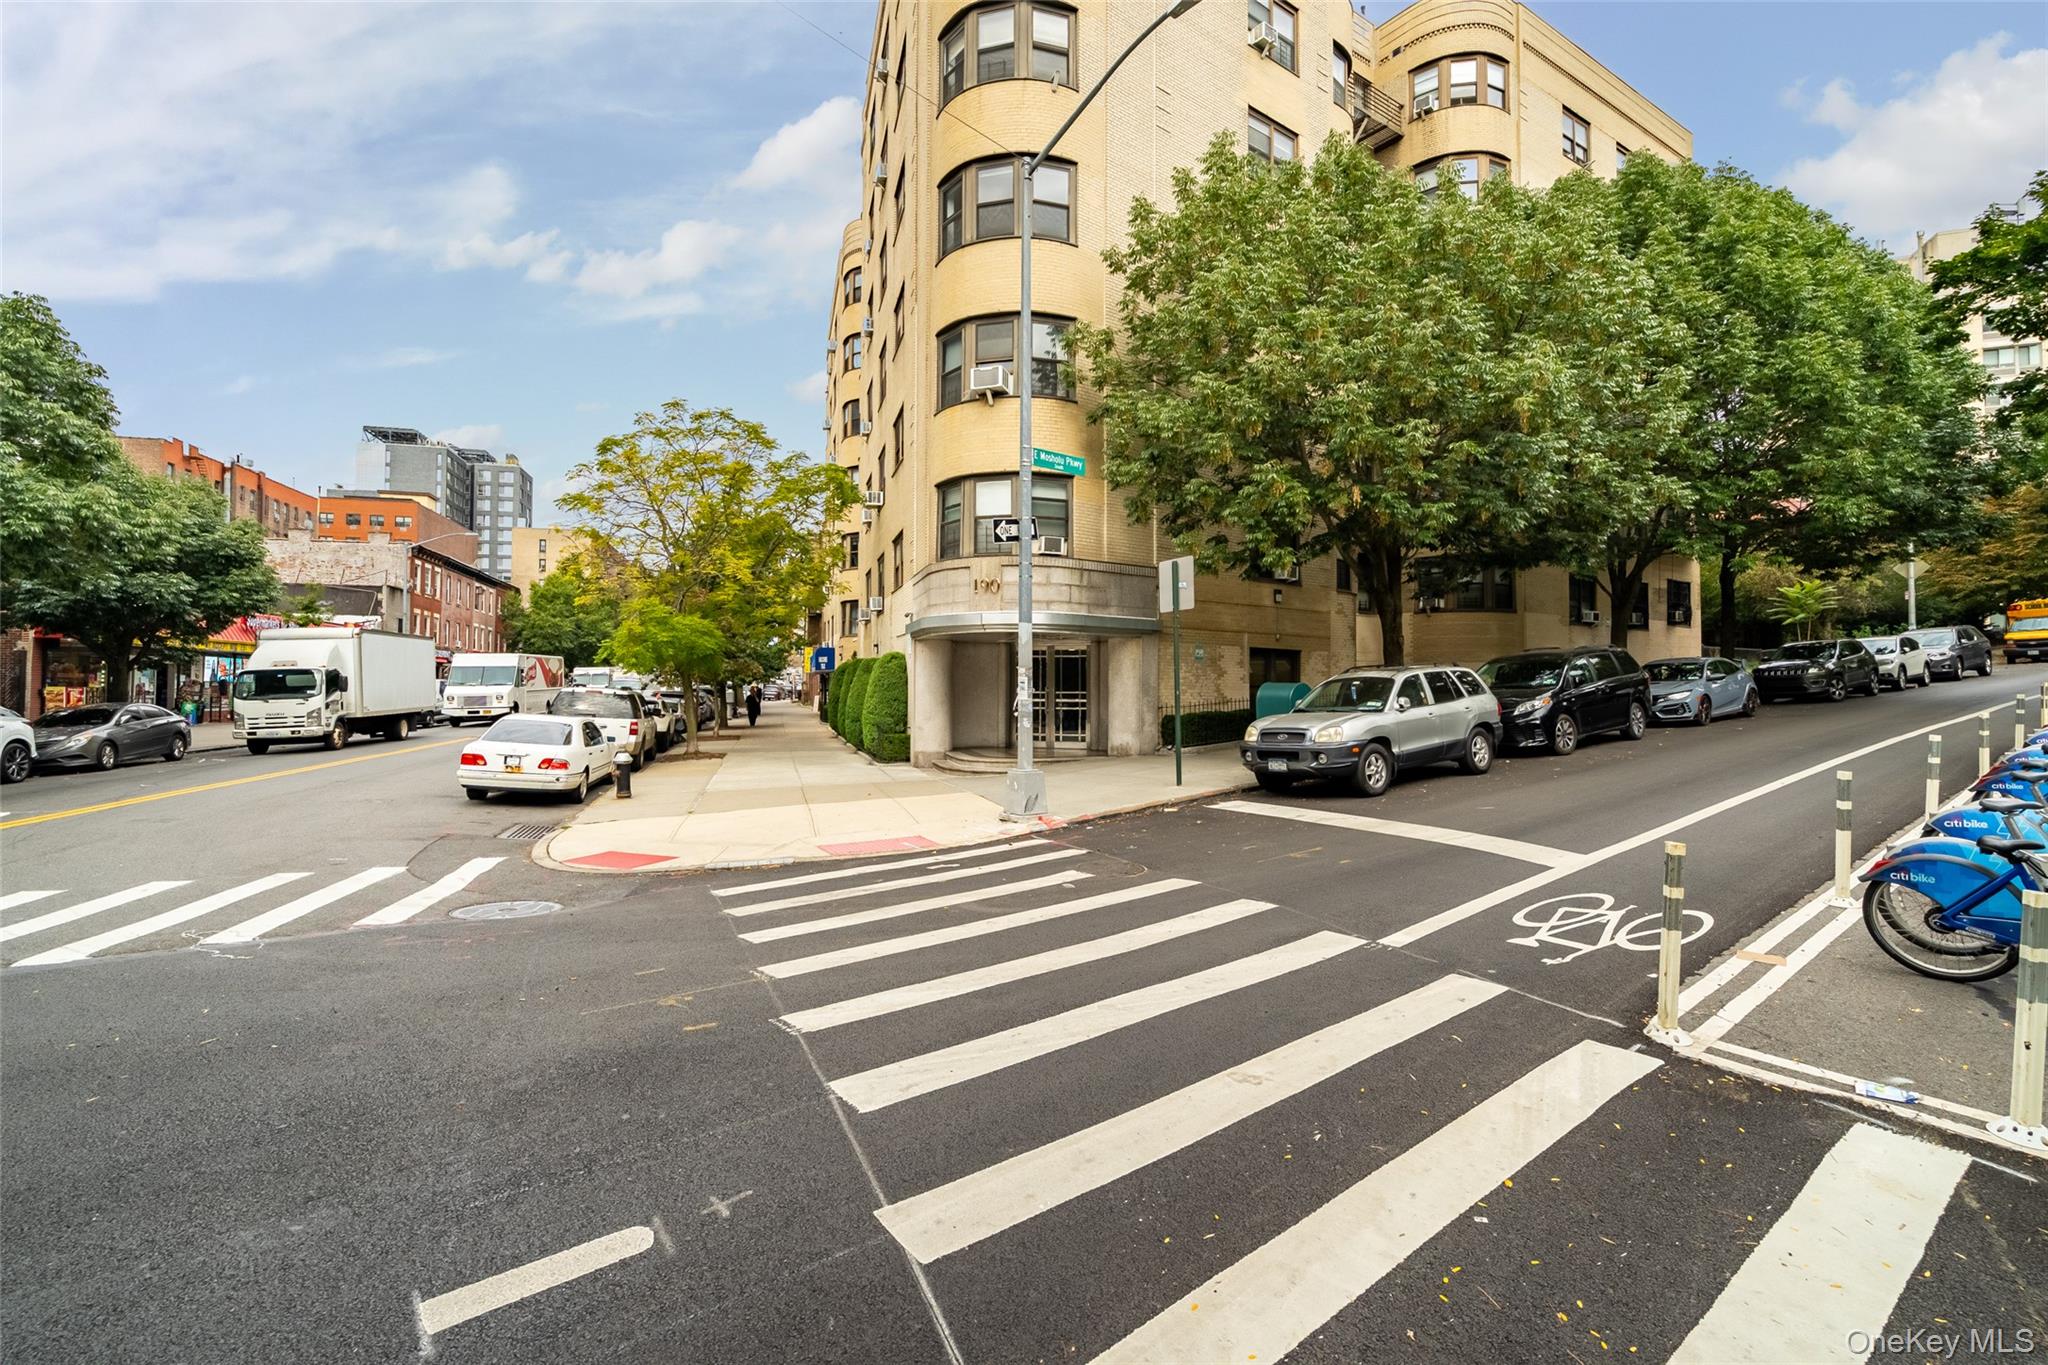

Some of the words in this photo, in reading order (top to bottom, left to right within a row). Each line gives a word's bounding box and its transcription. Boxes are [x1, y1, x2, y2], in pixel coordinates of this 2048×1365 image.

[1034, 450, 1039, 459] E
[1040, 451, 1064, 465] Mosholu
[1065, 456, 1083, 471] Pkwy
[1000, 525, 1013, 535] ONE
[973, 577, 1001, 595] 190
[1944, 819, 1962, 828] citi
[1963, 820, 1989, 829] bike
[1890, 871, 1909, 881] citi
[1910, 872, 1936, 884] bike
